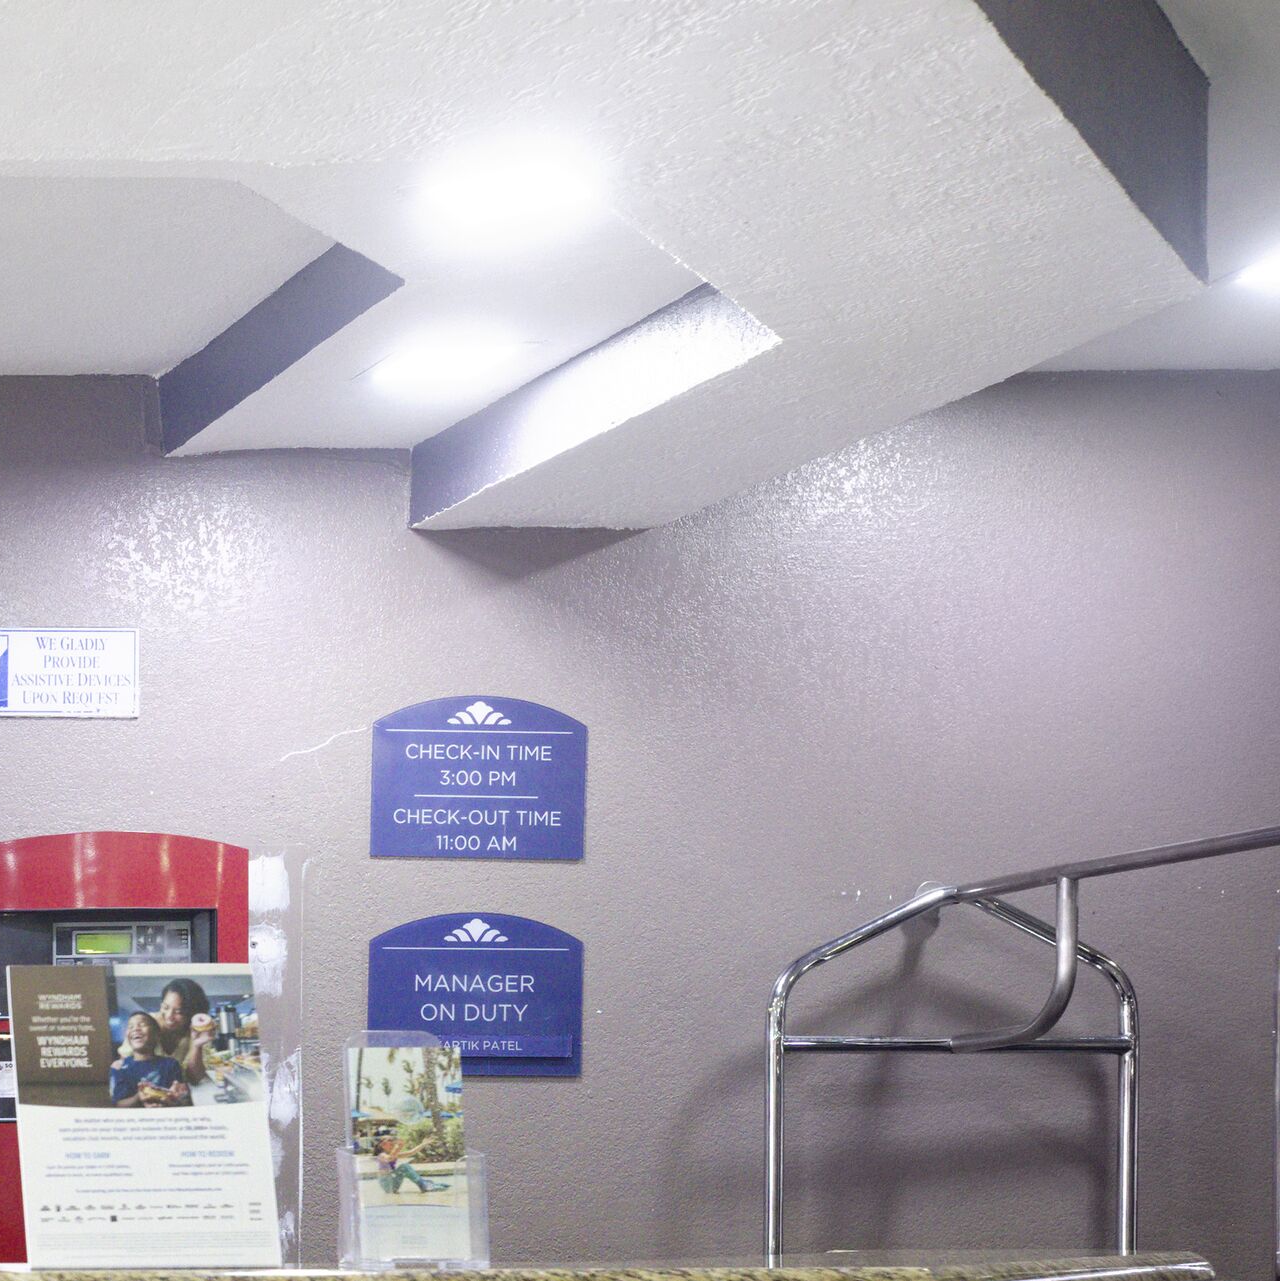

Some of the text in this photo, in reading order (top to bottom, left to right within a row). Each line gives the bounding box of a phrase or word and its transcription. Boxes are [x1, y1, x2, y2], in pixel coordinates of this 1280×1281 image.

[405, 743, 553, 761] CHECK-IN TIME
[440, 770, 516, 787] 3:00 PM
[393, 808, 562, 826] CHECK-OUT TIME
[436, 835, 517, 851] 11:00 AM
[414, 974, 535, 993] MANAGER
[420, 1003, 529, 1022] ON DUTY
[36, 1035, 89, 1046] WYNDHAM
[440, 1040, 523, 1051] ARTIK PATEL
[40, 1046, 88, 1057] REWARDS
